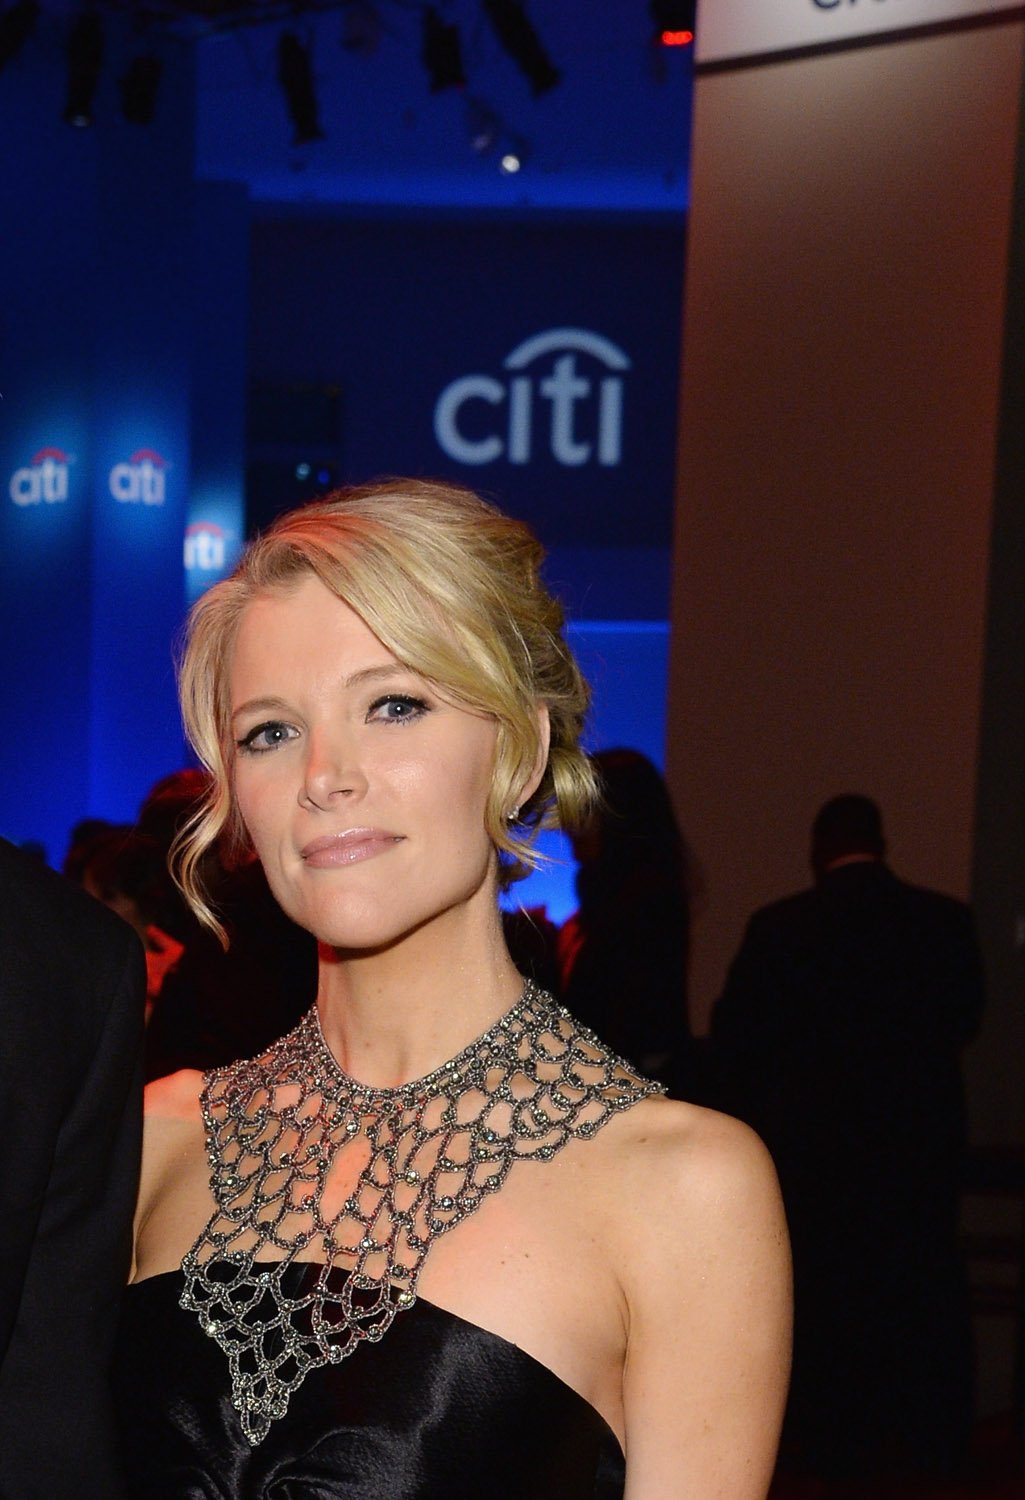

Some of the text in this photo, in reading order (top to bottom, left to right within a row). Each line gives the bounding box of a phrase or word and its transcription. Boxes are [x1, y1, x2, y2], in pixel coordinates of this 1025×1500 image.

[434, 326, 630, 466] citi
[9, 446, 70, 507] citi
[184, 521, 225, 570] iti
